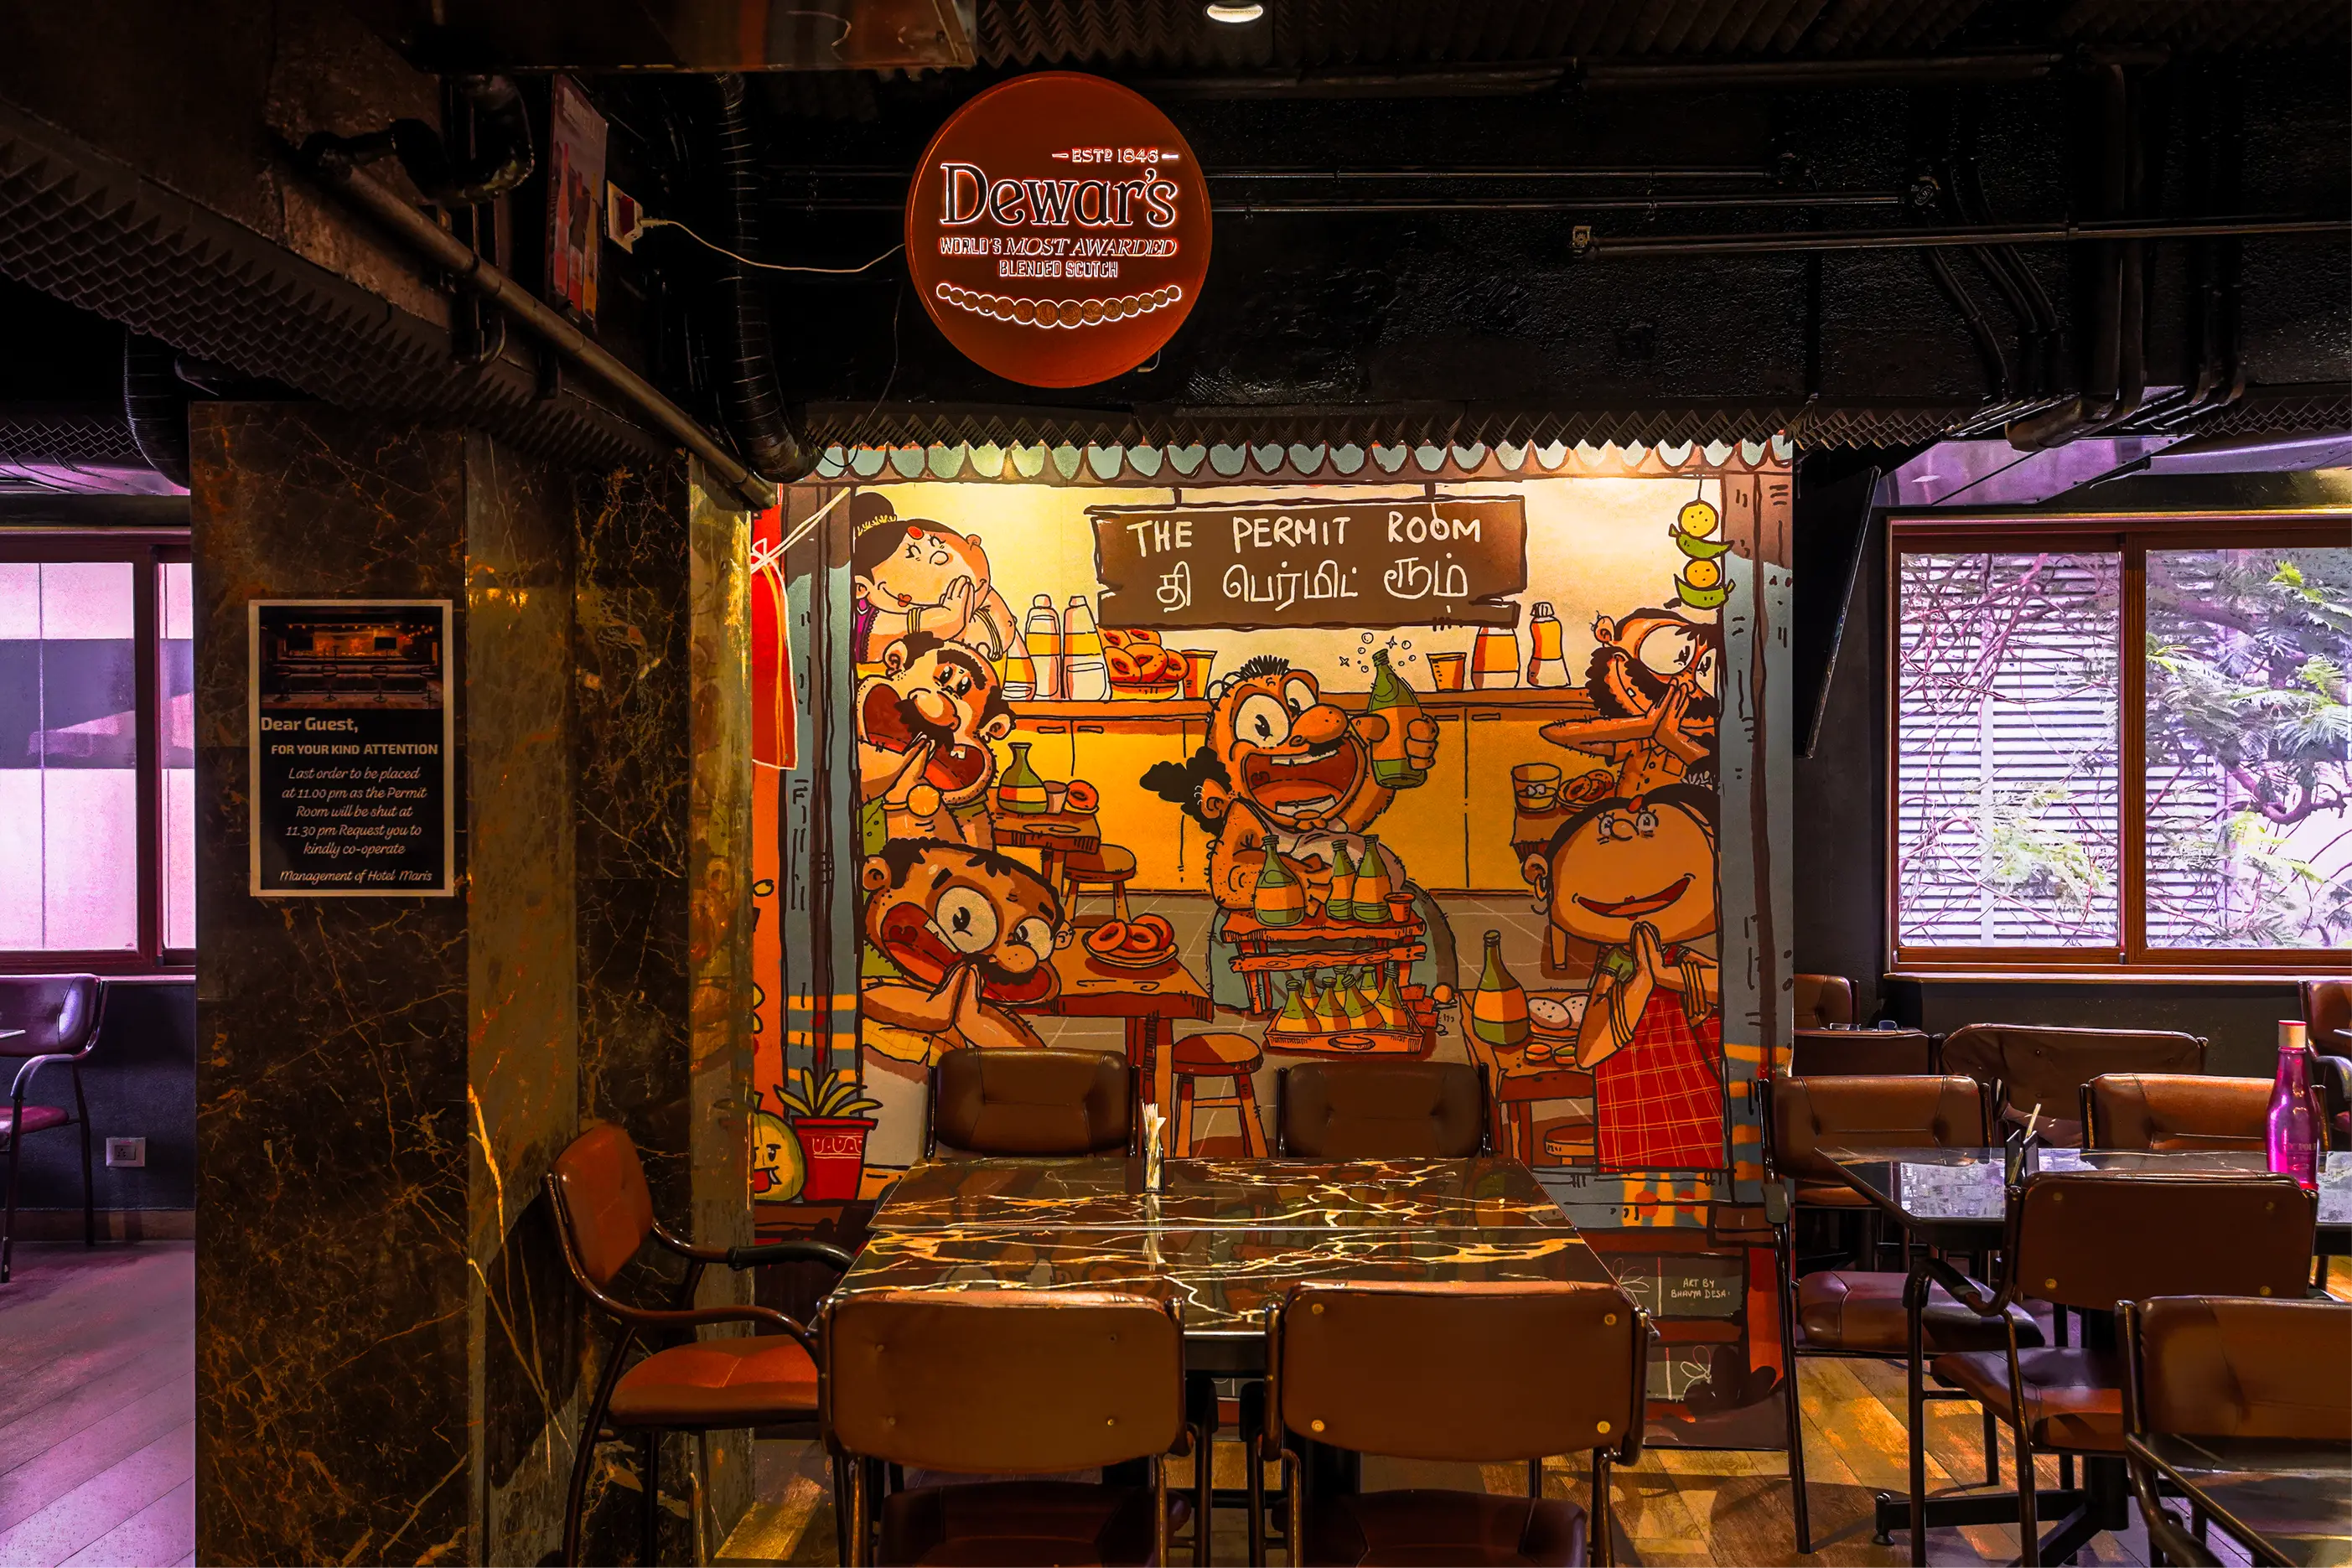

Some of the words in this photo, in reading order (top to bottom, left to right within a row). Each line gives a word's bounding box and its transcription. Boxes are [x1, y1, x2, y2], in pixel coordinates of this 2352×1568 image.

[1117, 148, 1158, 163] 1846
[940, 163, 1179, 227] Dewar's
[940, 237, 1002, 255] WORLD'S
[1005, 238, 1070, 256] MOST
[1070, 238, 1178, 256] AWARDED
[999, 261, 1061, 277] BLENDED
[1065, 261, 1118, 277] SCOTCH
[1127, 519, 1193, 557] THE
[1233, 516, 1351, 553] PERMIT
[1388, 511, 1481, 545] ROOM
[1156, 561, 1191, 613] தி
[1383, 552, 1469, 600] ரூம்
[261, 717, 302, 731] Dear
[304, 717, 359, 733] Guest,
[271, 744, 295, 755] FOR
[297, 744, 329, 755] YOUR
[331, 744, 360, 755] KIND
[364, 743, 438, 755] ATTENTION
[288, 767, 315, 779] Last
[316, 767, 349, 779] order
[350, 768, 362, 779] to
[364, 766, 379, 779] be
[378, 766, 421, 784] placed
[282, 787, 296, 799] at
[298, 789, 325, 799] 11.00
[326, 789, 349, 802] pm
[350, 789, 363, 799] as
[365, 786, 386, 799] the
[386, 786, 427, 799] Permit
[296, 805, 329, 817] Room
[331, 804, 354, 817] will
[354, 804, 369, 817] be
[370, 804, 397, 817] shut
[398, 805, 413, 817] at
[285, 825, 315, 837] 11.30
[316, 826, 338, 839] pm
[338, 824, 386, 839] Request
[385, 826, 409, 840] you
[410, 825, 422, 836] to
[303, 841, 341, 858] kindly
[342, 843, 406, 857] co-operate
[279, 870, 353, 885] Management
[354, 869, 367, 884] of
[367, 869, 396, 882] Hotel
[399, 870, 433, 882] Maris
[1682, 1277, 1700, 1288] ART
[1702, 1277, 1715, 1289] BY
